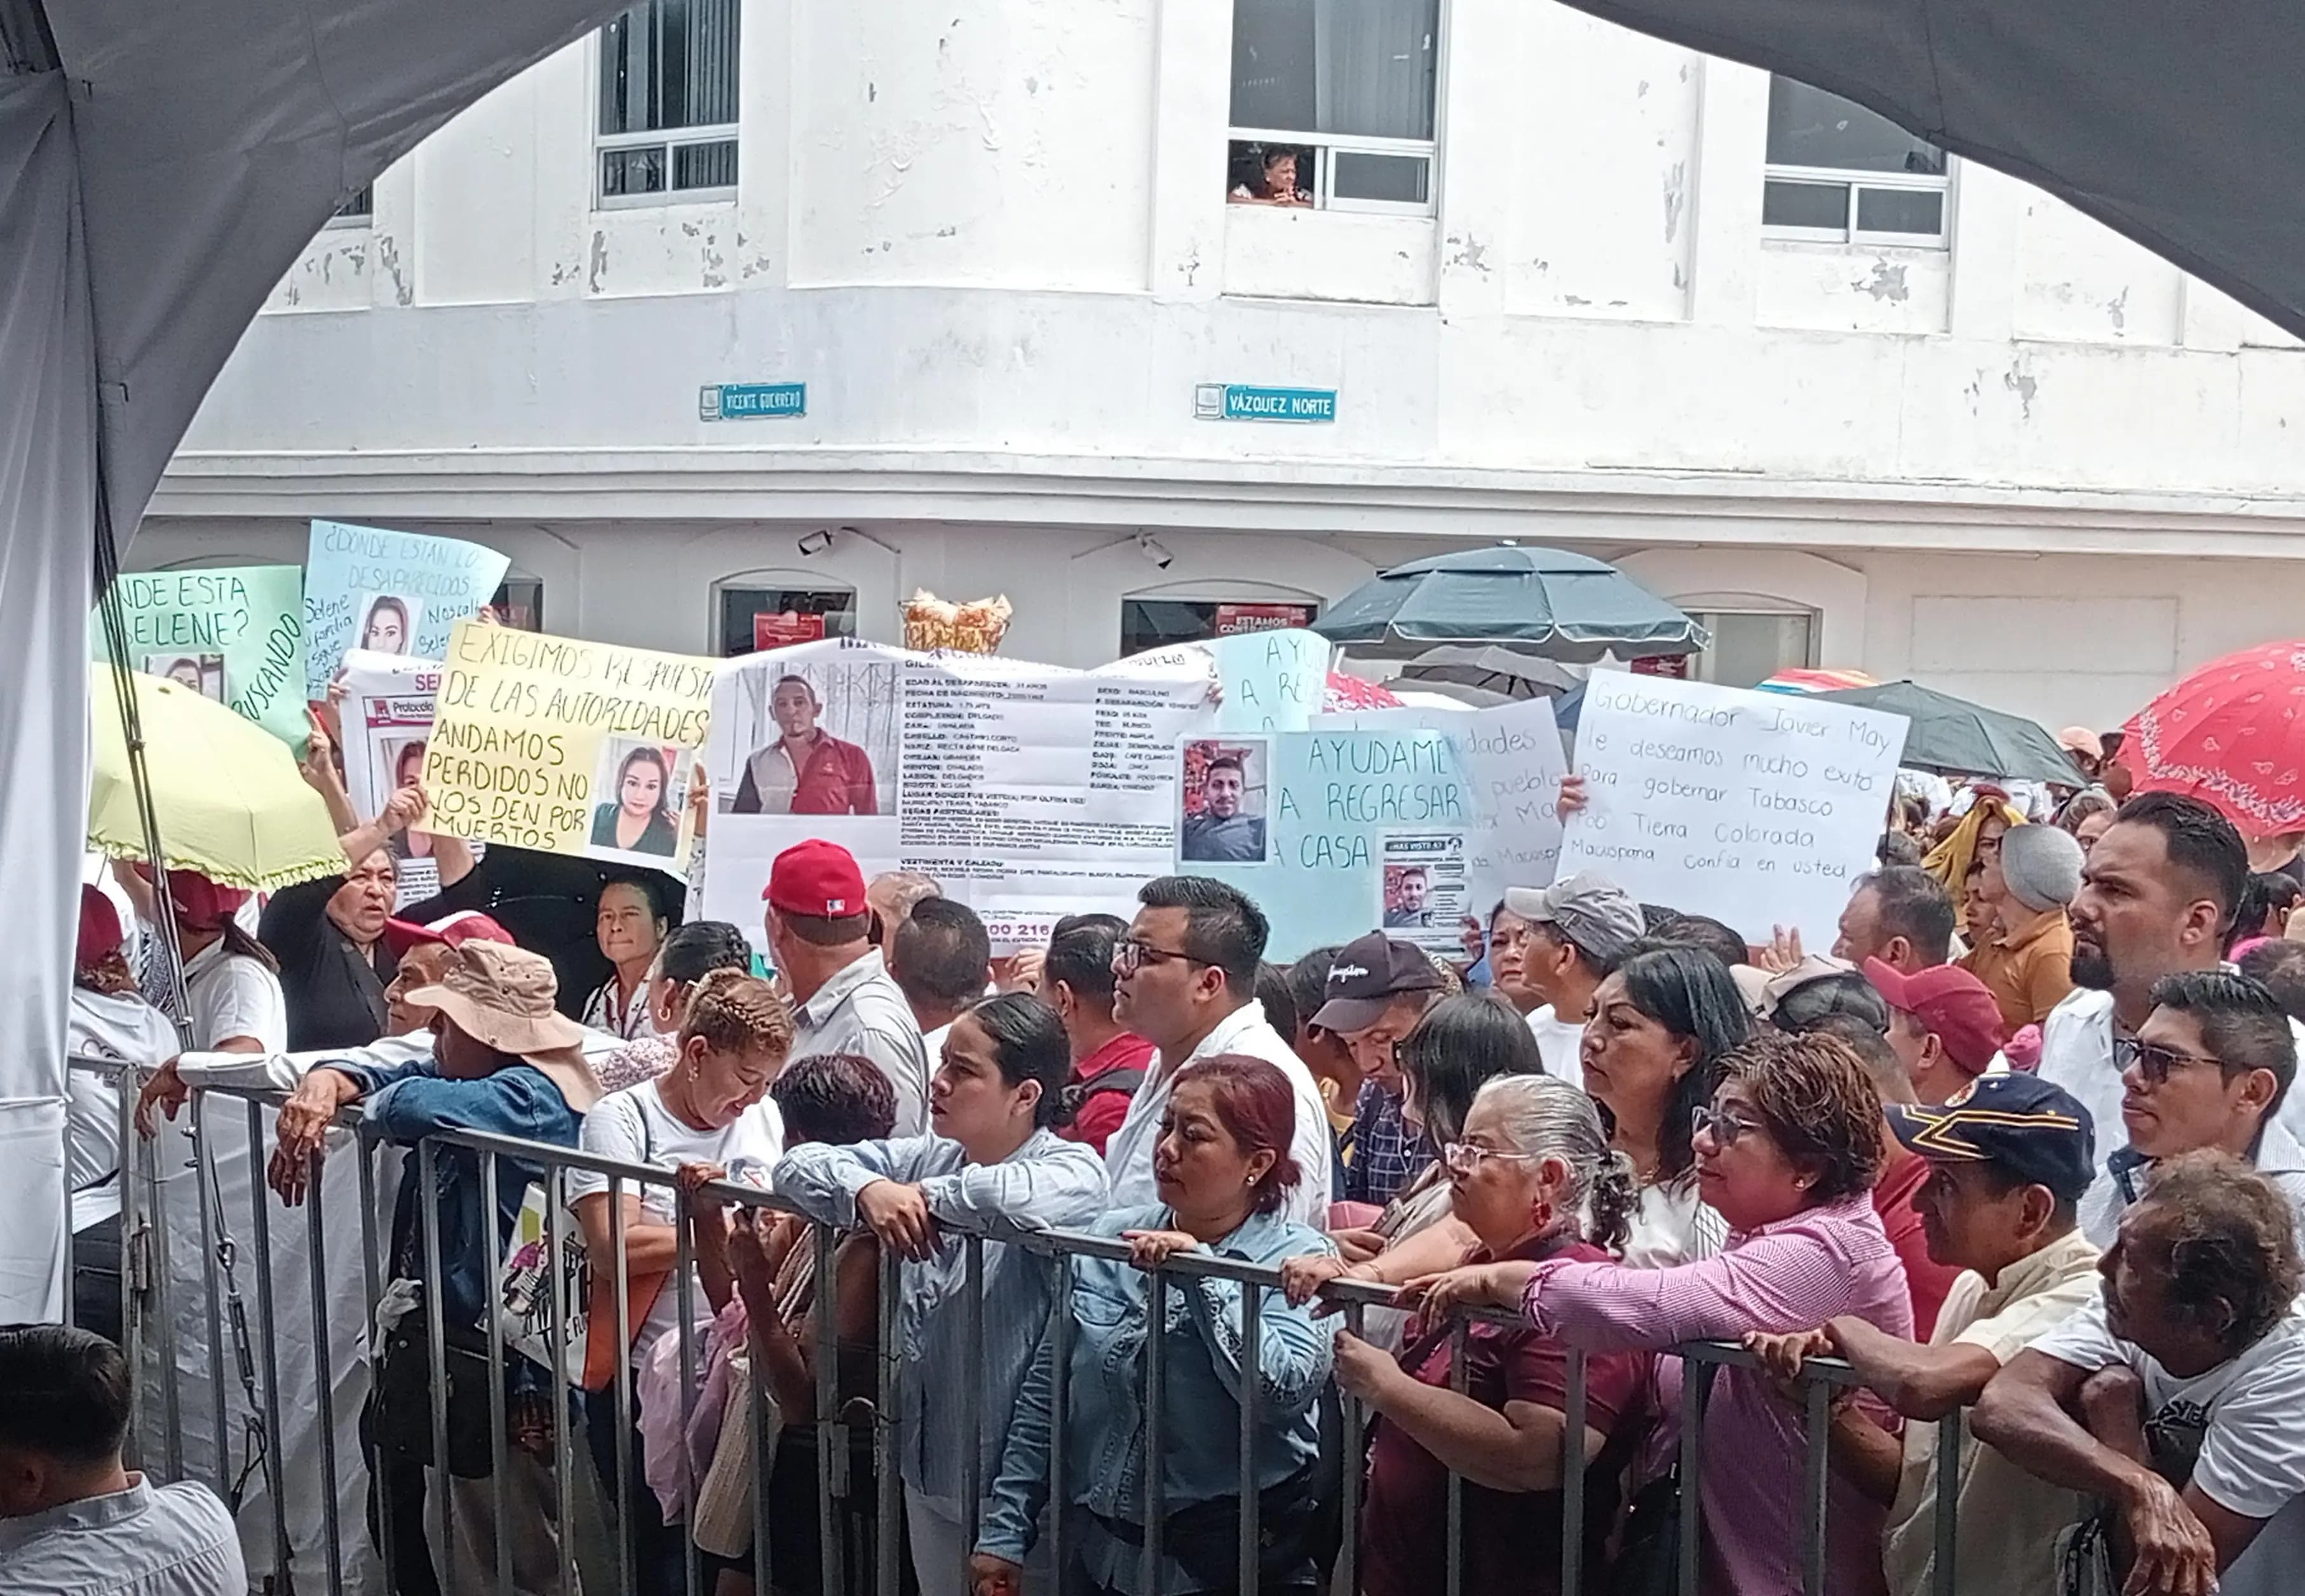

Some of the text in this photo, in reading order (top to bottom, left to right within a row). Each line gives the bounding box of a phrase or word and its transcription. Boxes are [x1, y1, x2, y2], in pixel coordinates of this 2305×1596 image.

[726, 393, 756, 409] VICENTE
[1229, 393, 1332, 415] VÁZQUEZ NORTE
[455, 544, 483, 568] LO
[179, 576, 250, 608] ESTA
[1236, 616, 1288, 626] ESTAMOS
[459, 623, 594, 679] EXIGIMOS
[393, 701, 434, 712] Protocolo
[444, 670, 710, 750] DE LAS AUTORIDADES
[1240, 679, 1261, 707] A
[1595, 681, 1890, 758] Gobernador Javier May
[433, 718, 565, 766] ANDAMOS
[1308, 738, 1448, 775] AYUDAME
[1629, 738, 1723, 768] deseamos
[1743, 752, 1809, 778] mucho
[426, 752, 589, 801] PERDIDOS NO
[1278, 787, 1301, 820] A
[1327, 782, 1462, 822] REGRESAR
[1642, 776, 1729, 802] gobernar
[1748, 787, 1834, 816] Tabasco
[433, 813, 557, 850] MUERTOS
[490, 797, 539, 825] DEN
[550, 806, 586, 832] POR
[1629, 811, 1689, 839] Tierra
[1715, 821, 1815, 848] Colorada
[1300, 834, 1370, 869] CASA
[1757, 858, 1776, 872] en
[1793, 859, 1846, 880] usted
[1018, 924, 1050, 936] 216
